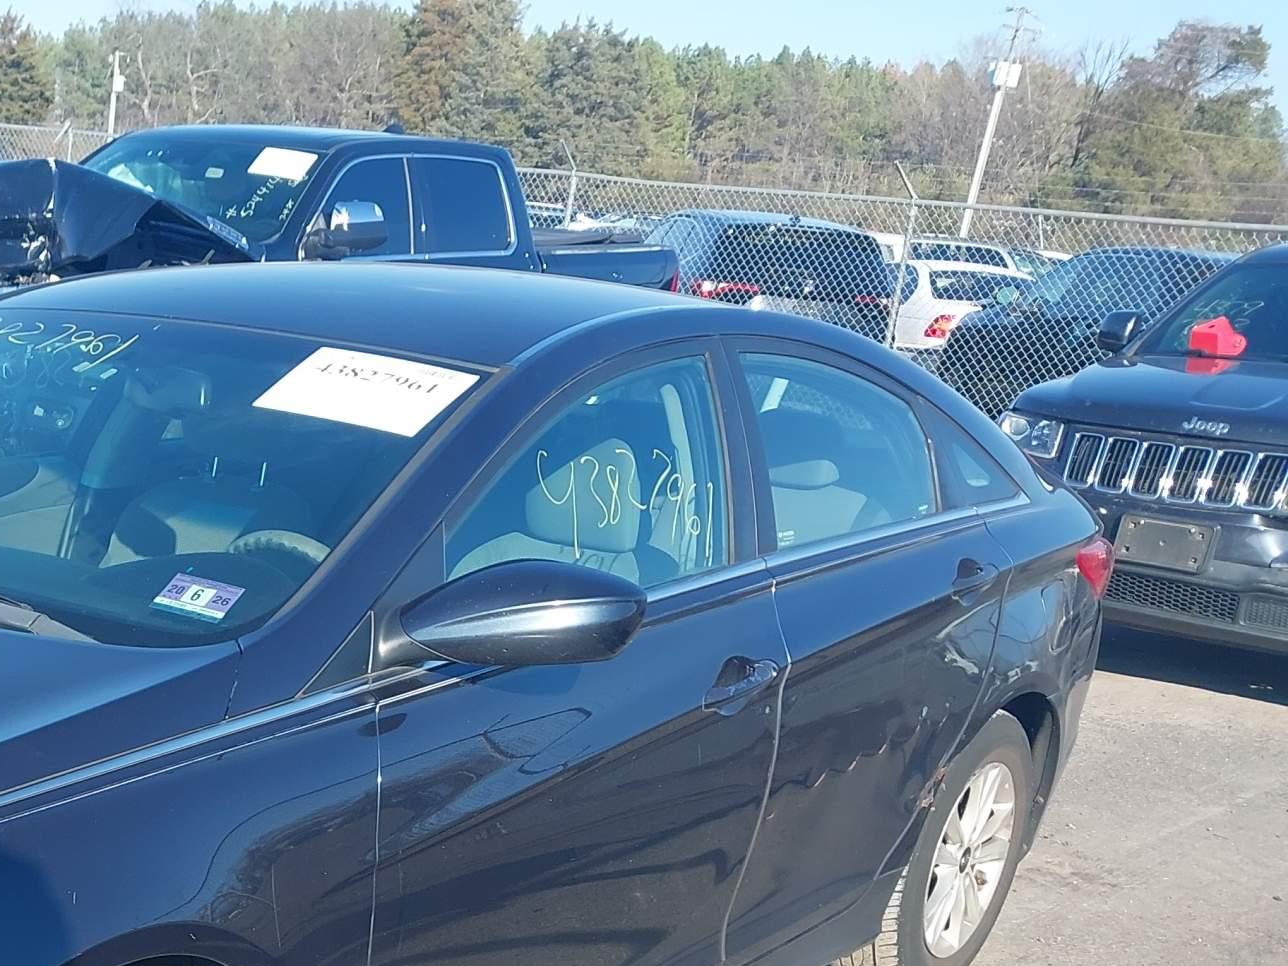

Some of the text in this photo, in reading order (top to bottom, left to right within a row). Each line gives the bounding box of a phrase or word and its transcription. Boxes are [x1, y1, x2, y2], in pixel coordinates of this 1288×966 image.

[1181, 416, 1231, 436] Jeep
[166, 584, 186, 596] 20
[190, 588, 205, 602] 6
[211, 595, 232, 607] 26
